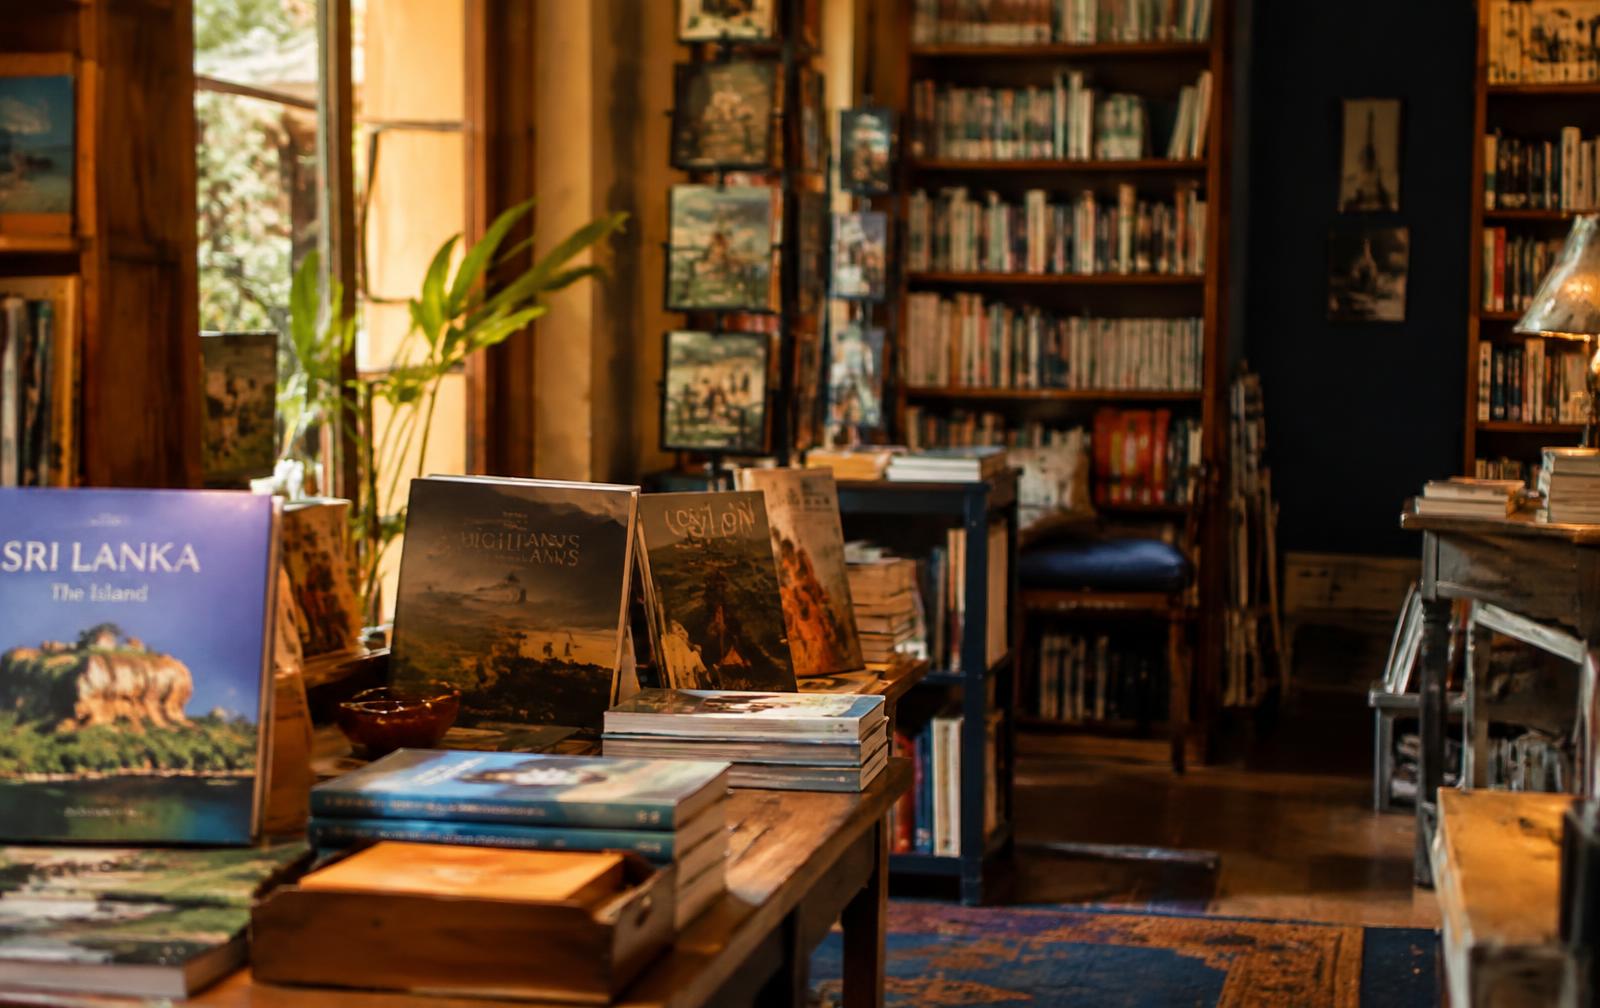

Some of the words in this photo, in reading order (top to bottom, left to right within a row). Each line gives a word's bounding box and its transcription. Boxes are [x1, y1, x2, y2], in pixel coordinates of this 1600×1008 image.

[1, 540, 59, 573] SRI
[72, 541, 201, 573] LANKA
[51, 582, 85, 603] The
[91, 582, 149, 603] Island
